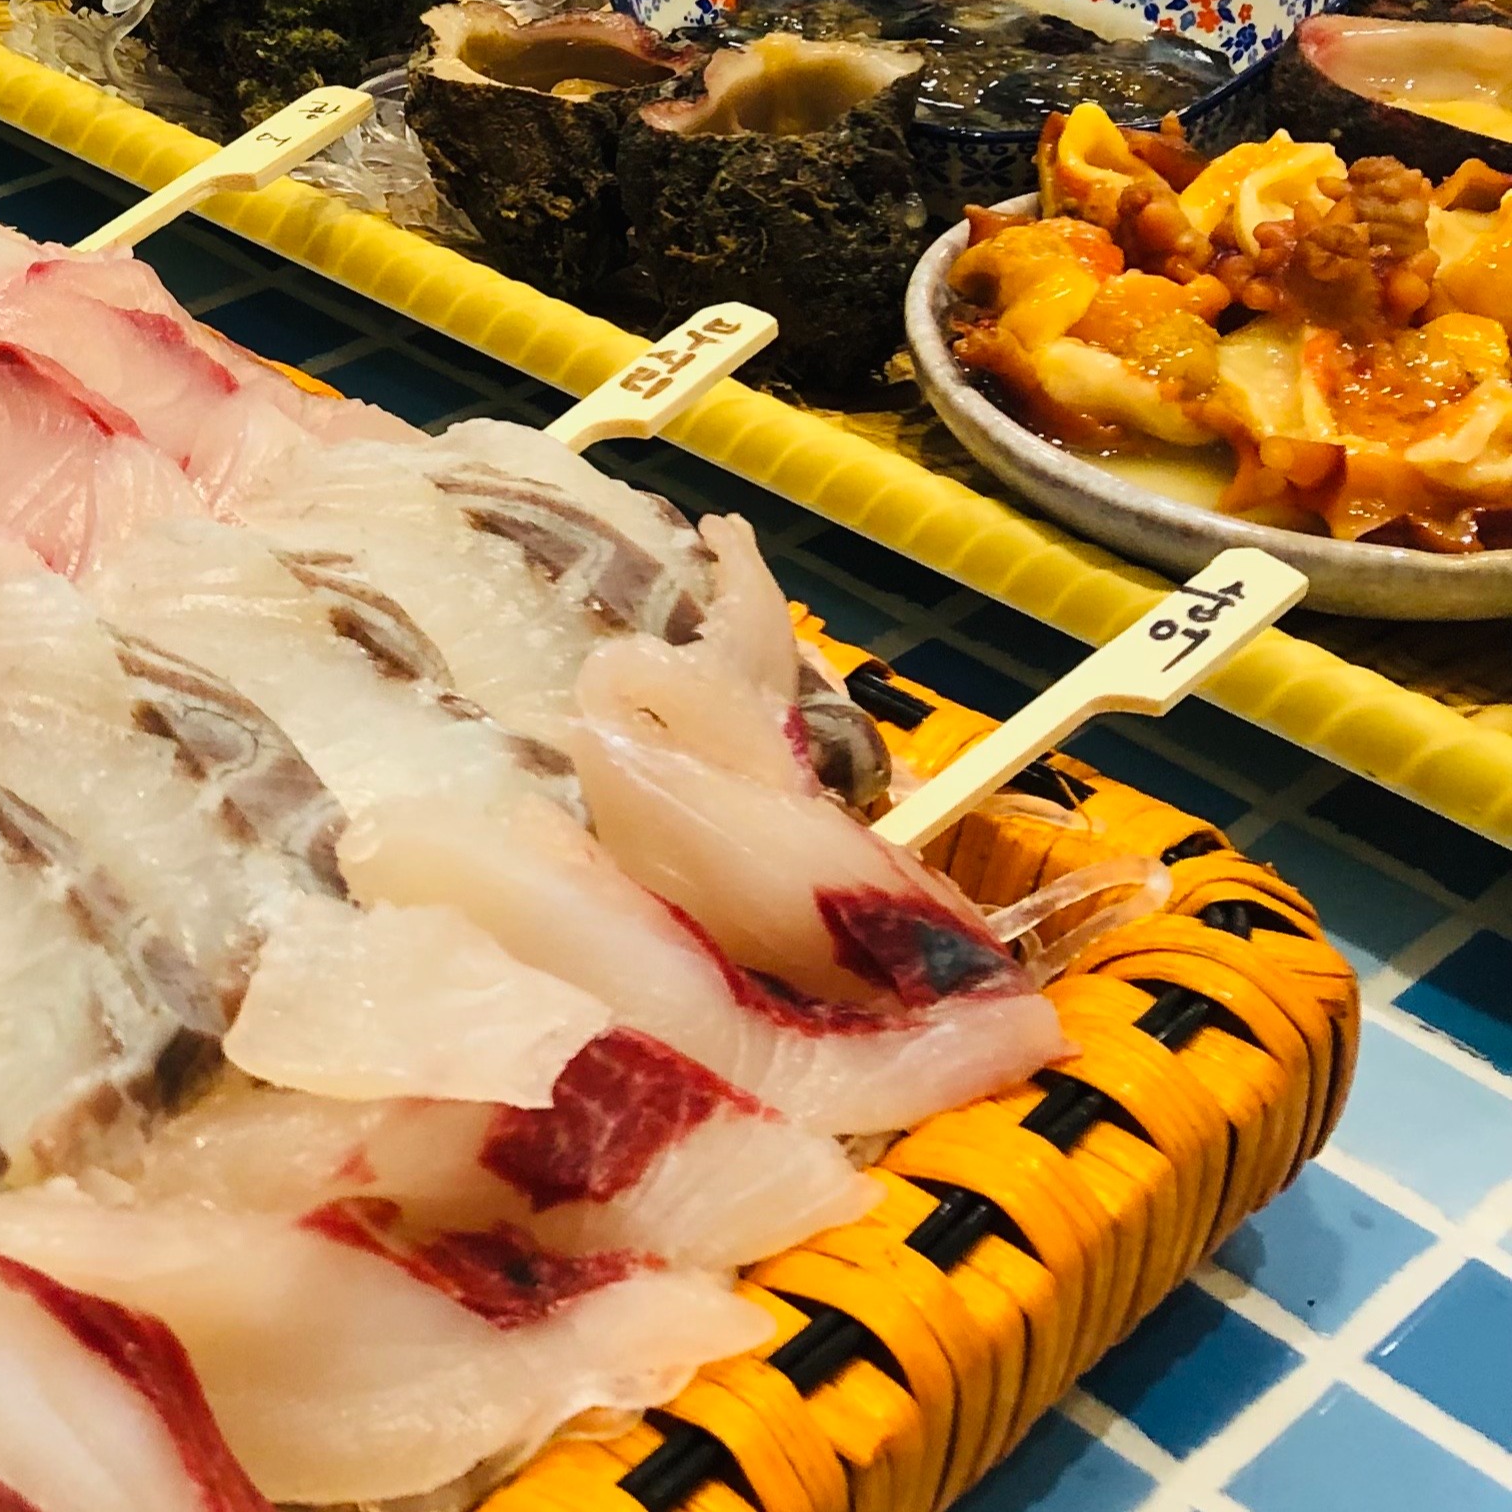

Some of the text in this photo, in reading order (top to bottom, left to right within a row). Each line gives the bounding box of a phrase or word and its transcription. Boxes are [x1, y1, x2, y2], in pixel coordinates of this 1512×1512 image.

[255, 100, 341, 148] 광어
[619, 317, 742, 400] 부시리
[1148, 580, 1245, 673] 숭어
